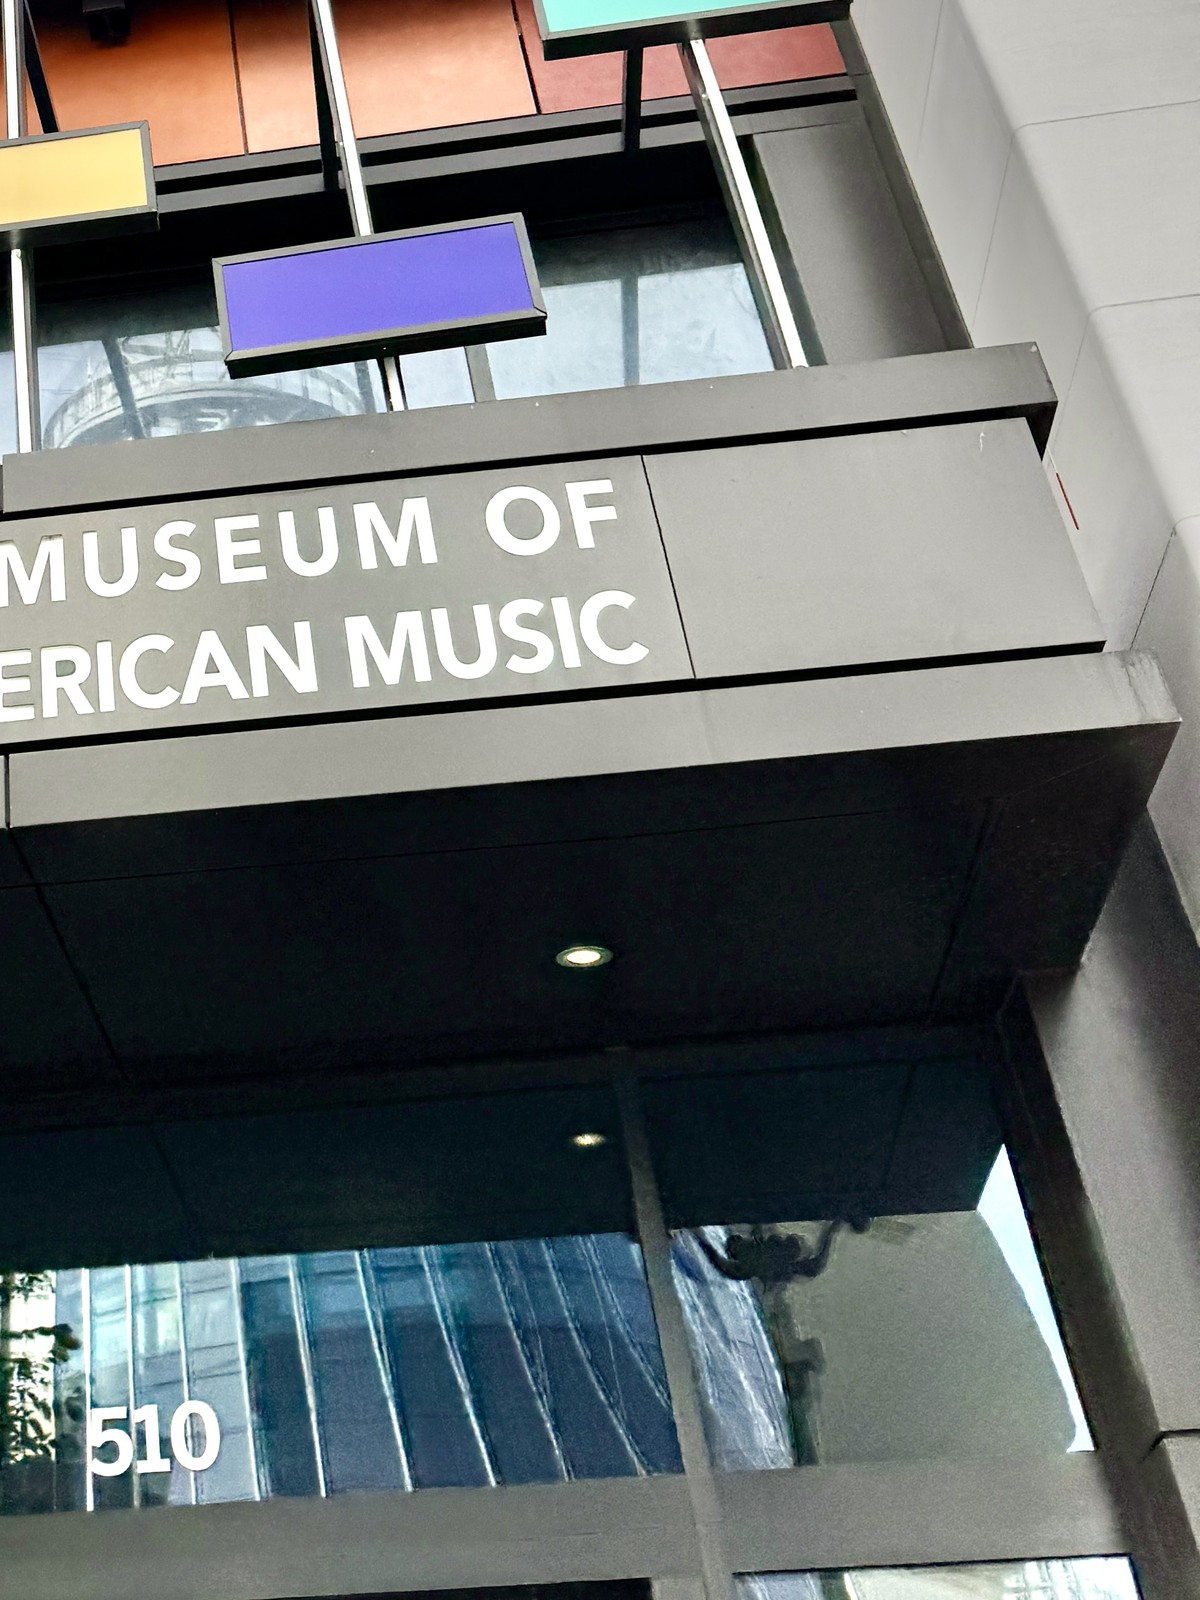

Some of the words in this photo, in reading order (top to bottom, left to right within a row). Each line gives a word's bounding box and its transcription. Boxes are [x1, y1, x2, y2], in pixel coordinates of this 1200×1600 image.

[484, 478, 618, 557] OF
[344, 590, 650, 688] MUSIC
[88, 1399, 221, 1477] 510
